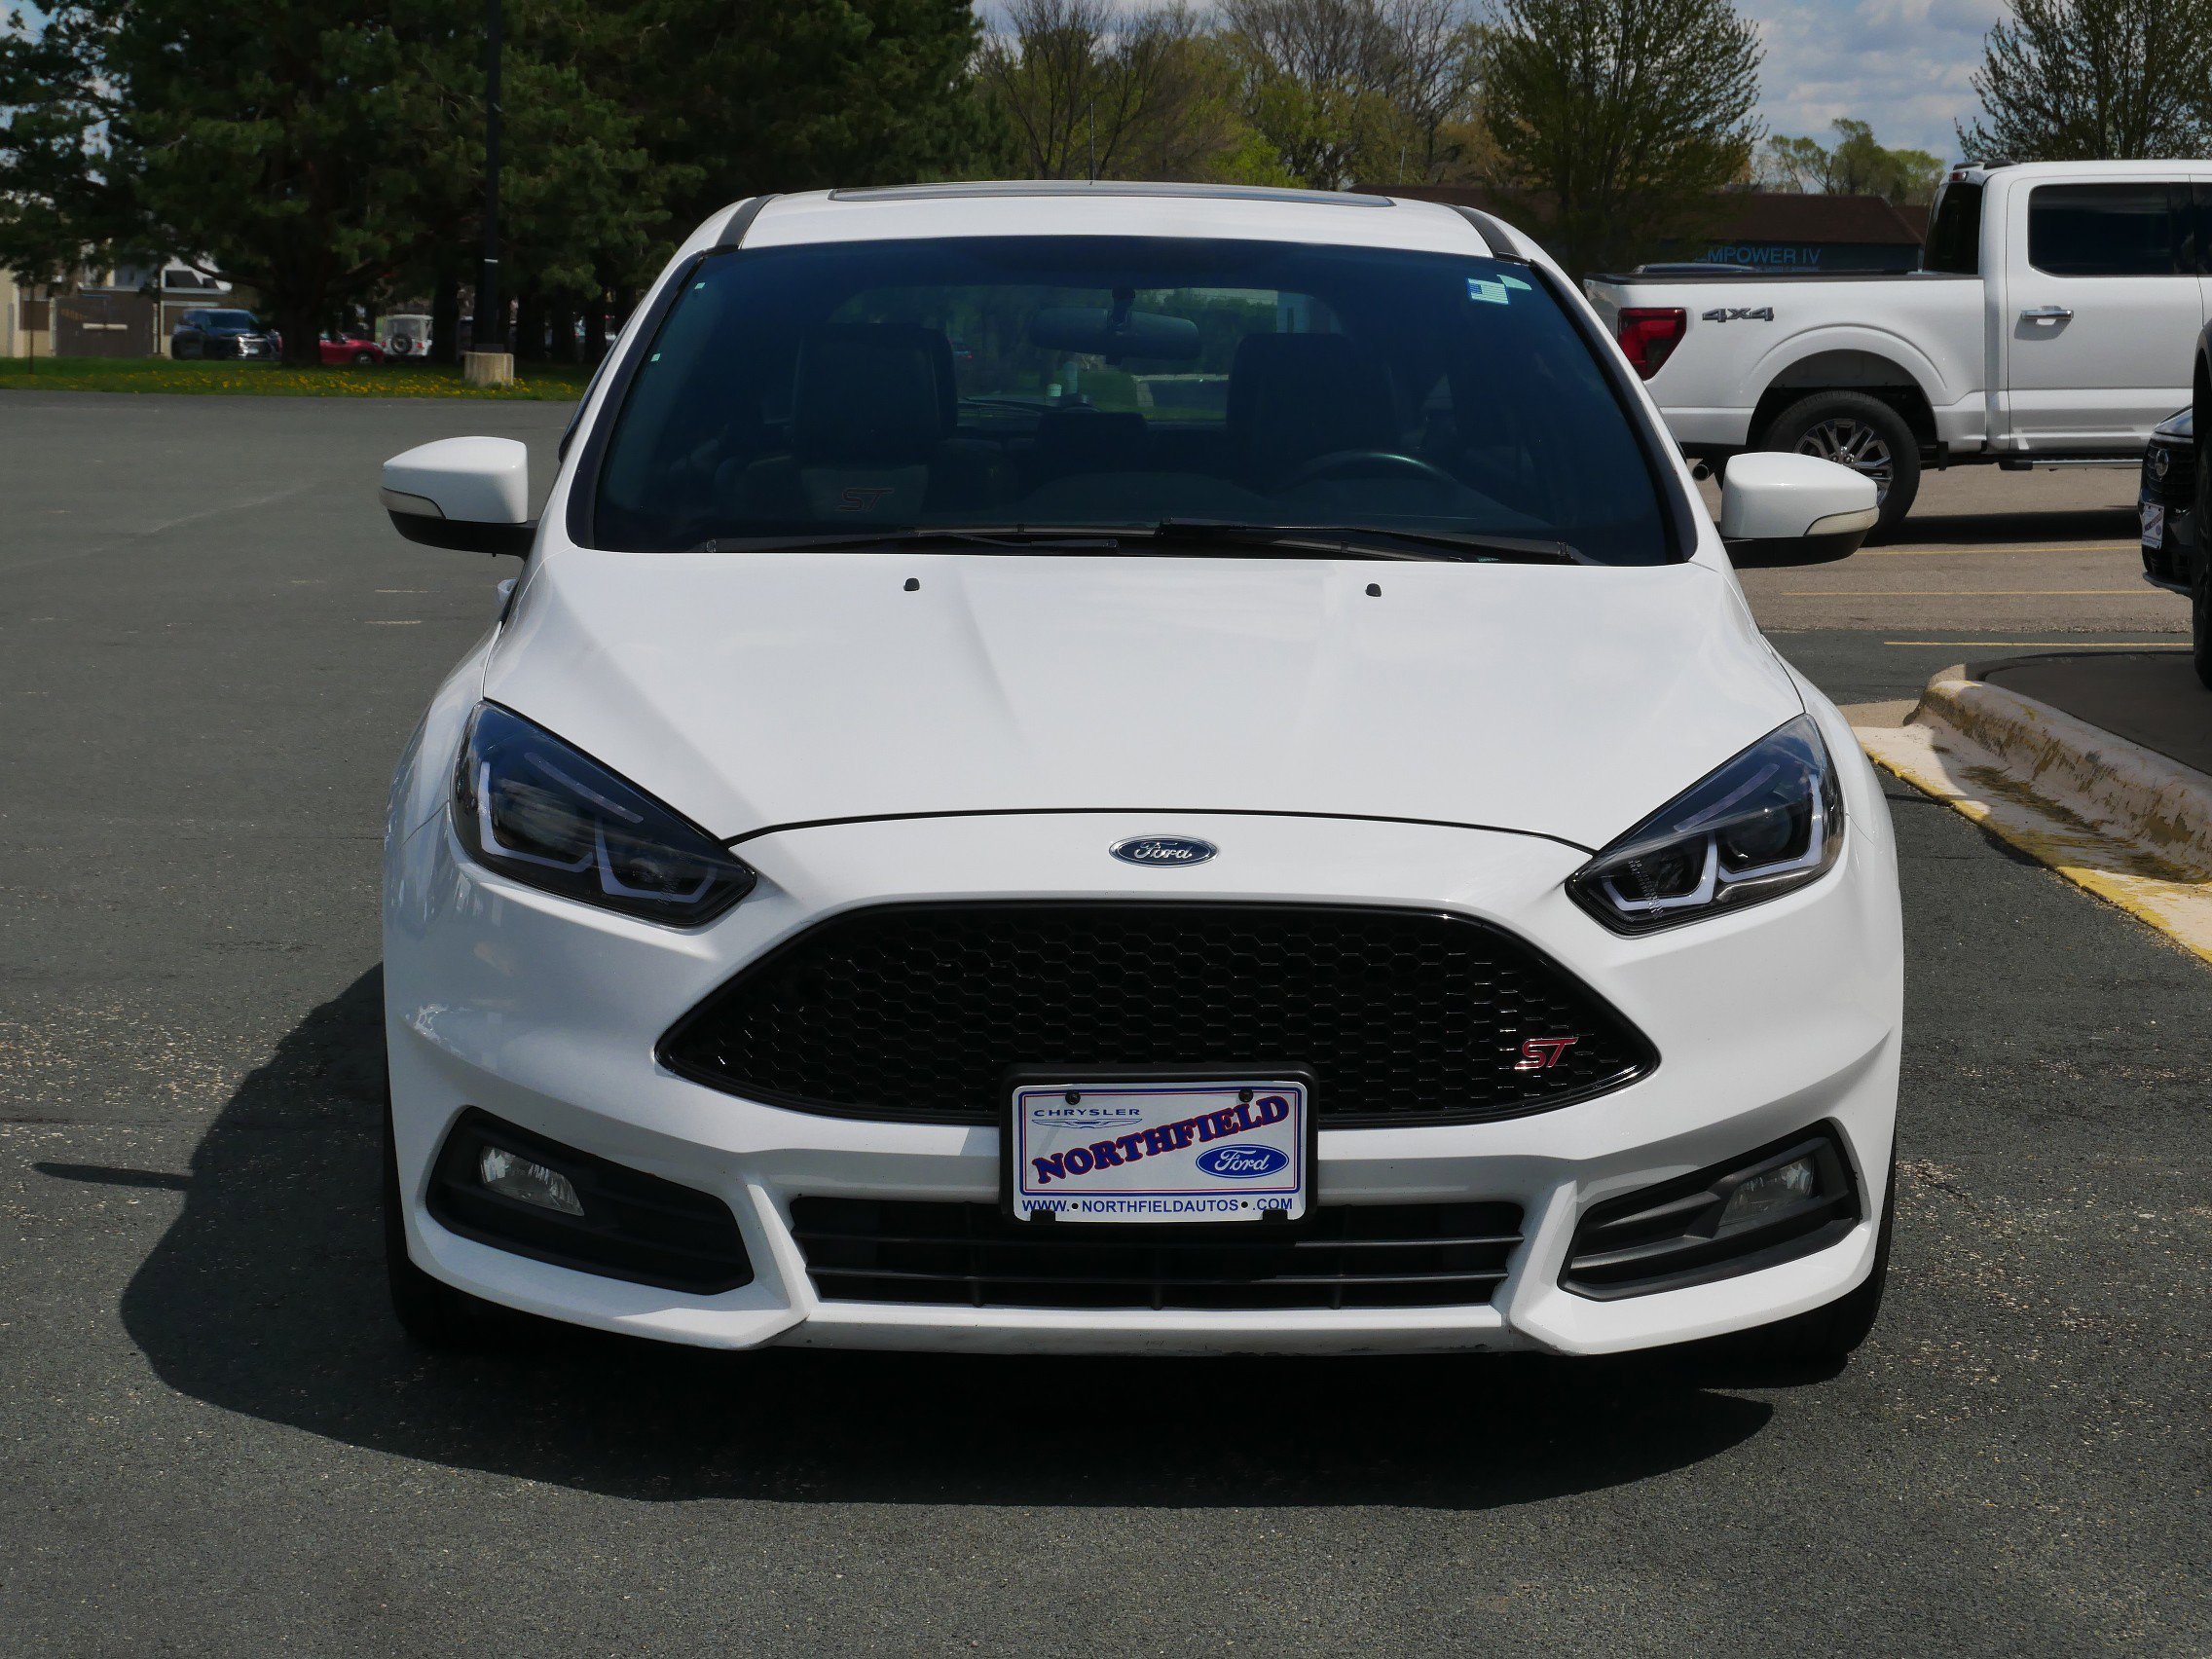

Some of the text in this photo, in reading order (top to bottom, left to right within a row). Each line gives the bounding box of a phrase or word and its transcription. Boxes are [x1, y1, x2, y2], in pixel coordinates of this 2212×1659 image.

[1802, 248, 1822, 264] IV
[834, 488, 894, 512] ST
[1133, 841, 1193, 859] Ford
[1514, 1037, 1579, 1070] ST
[1034, 1108, 1141, 1117] CHRYSLER
[1032, 1095, 1290, 1184] NORTHFIELD
[1214, 1149, 1270, 1172] Ford
